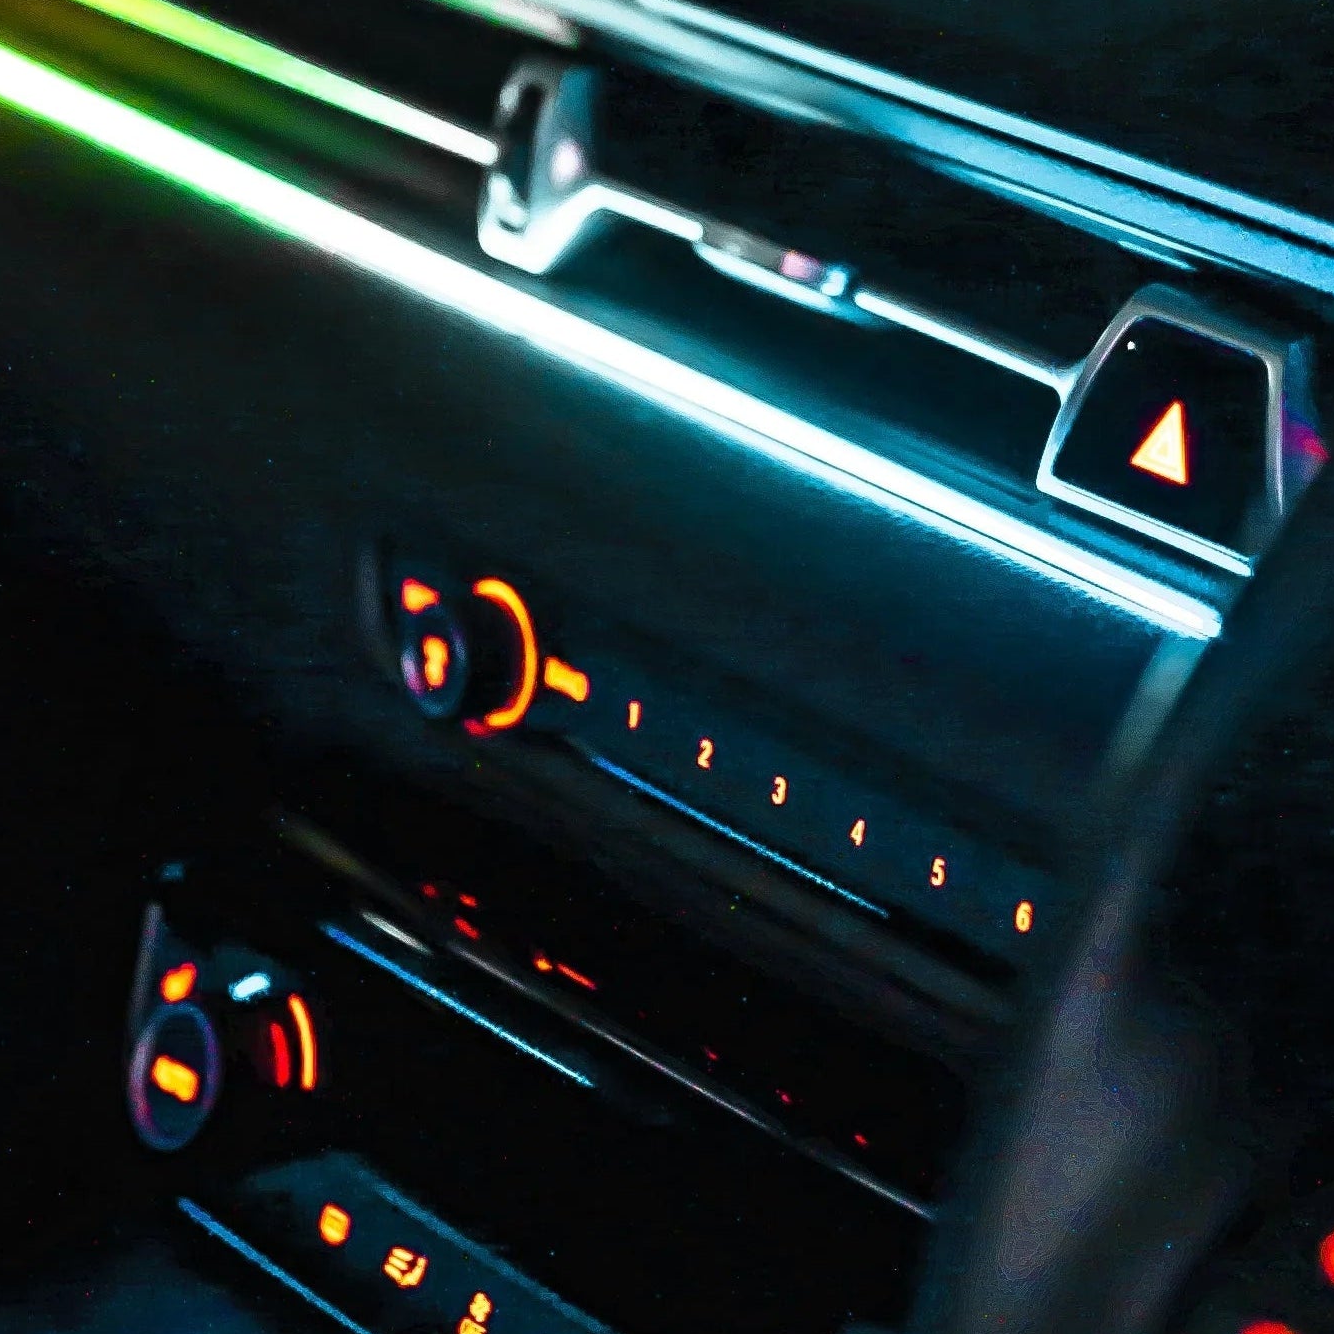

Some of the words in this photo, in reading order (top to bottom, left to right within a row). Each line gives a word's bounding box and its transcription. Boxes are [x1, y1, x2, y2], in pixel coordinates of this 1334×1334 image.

[627, 700, 641, 730] 1
[698, 738, 713, 768] 2
[771, 776, 787, 805] 3
[850, 819, 865, 847] 4
[930, 857, 945, 887] 5
[1015, 900, 1033, 933] 6
